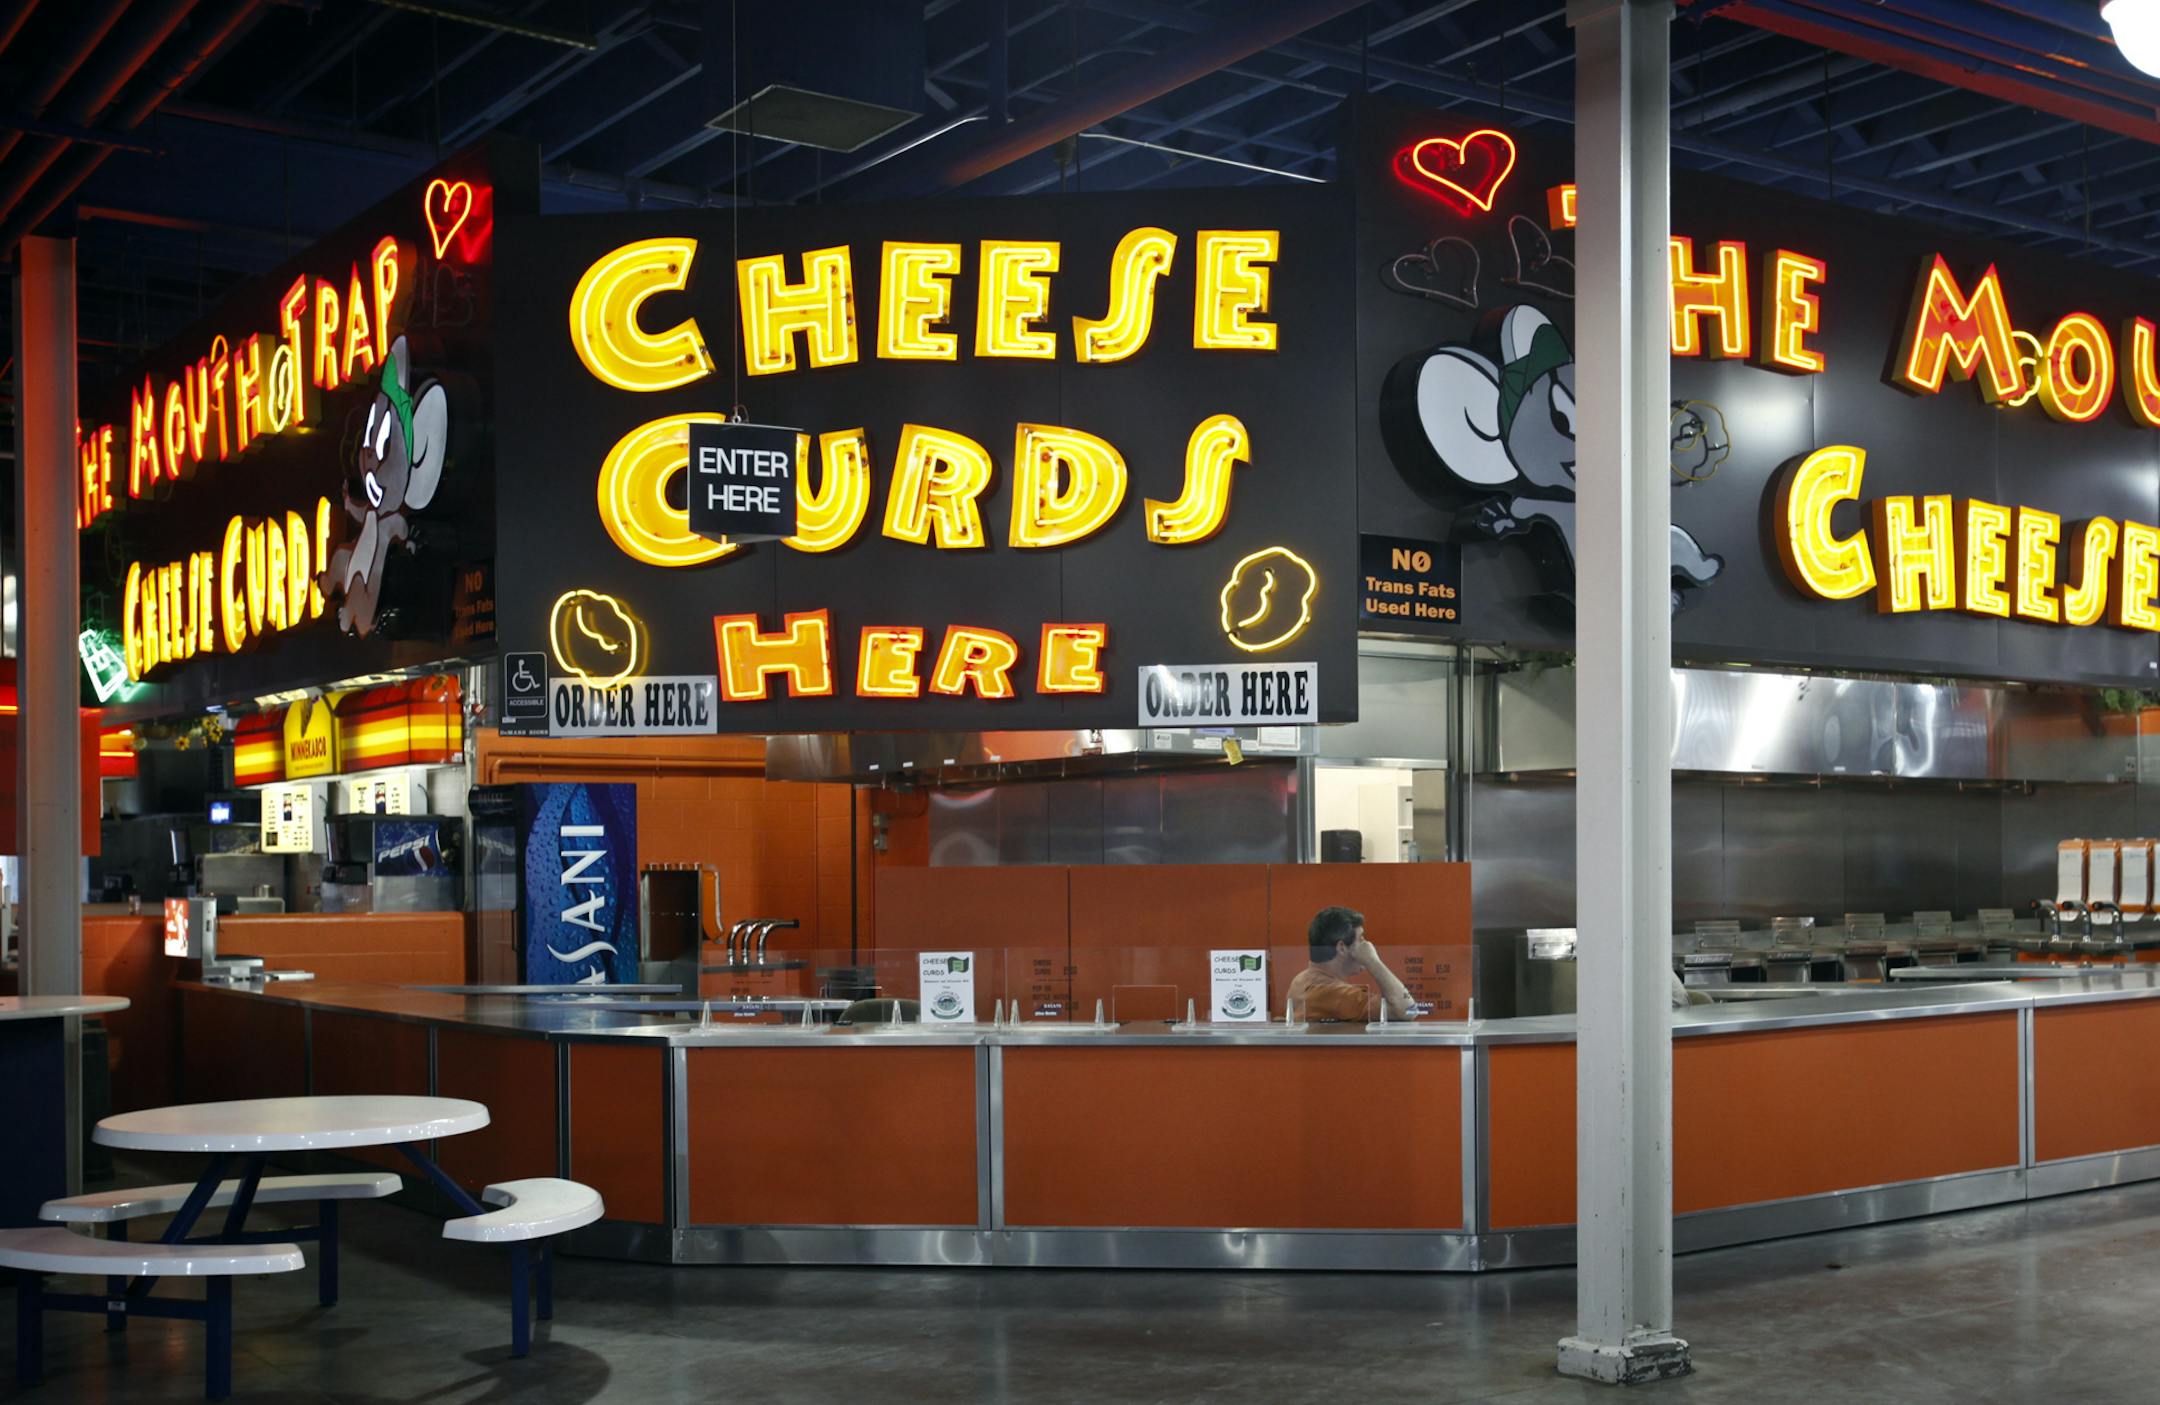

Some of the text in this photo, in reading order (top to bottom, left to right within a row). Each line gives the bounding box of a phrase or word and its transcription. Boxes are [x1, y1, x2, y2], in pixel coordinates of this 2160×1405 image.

[569, 227, 1280, 392] CHEESE
[76, 235, 399, 528] HE MOUTH TRAP
[699, 446, 789, 478] ENTER
[597, 413, 1252, 567] CURDS
[707, 483, 781, 513] HERE
[1392, 547, 1431, 573] NO
[1780, 445, 2160, 632] CHEESE
[123, 496, 331, 683] CHEESE CURDS
[1366, 576, 1455, 599] Trans Fats
[1366, 598, 1456, 620] Used Here
[713, 608, 1106, 702] HERE
[556, 682, 709, 728] ORDER HERE
[1146, 671, 1309, 717] ORDER HERE
[378, 834, 430, 863] PEPSI
